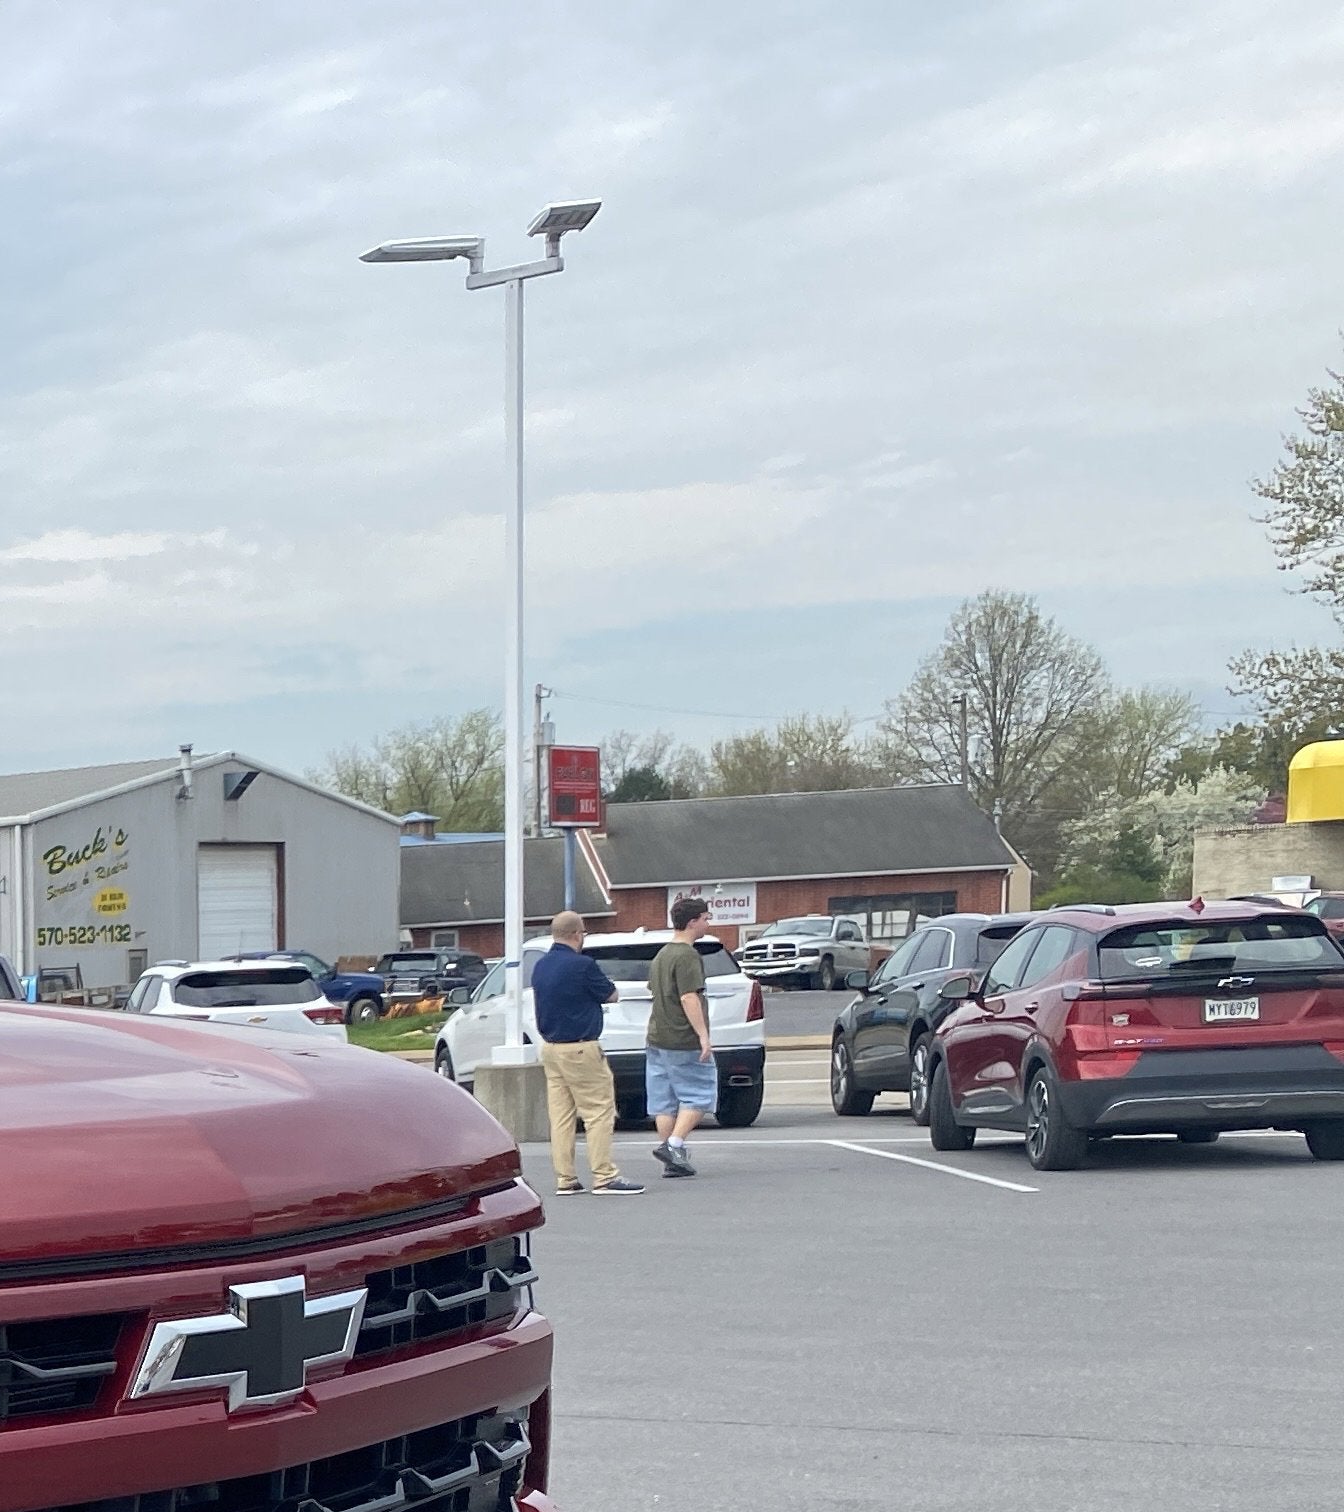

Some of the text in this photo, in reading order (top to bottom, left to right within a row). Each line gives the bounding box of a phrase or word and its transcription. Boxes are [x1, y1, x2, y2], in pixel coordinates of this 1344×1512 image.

[43, 826, 128, 875] Buck's
[706, 896, 750, 908] riental
[37, 924, 132, 947] 570-523-1132
